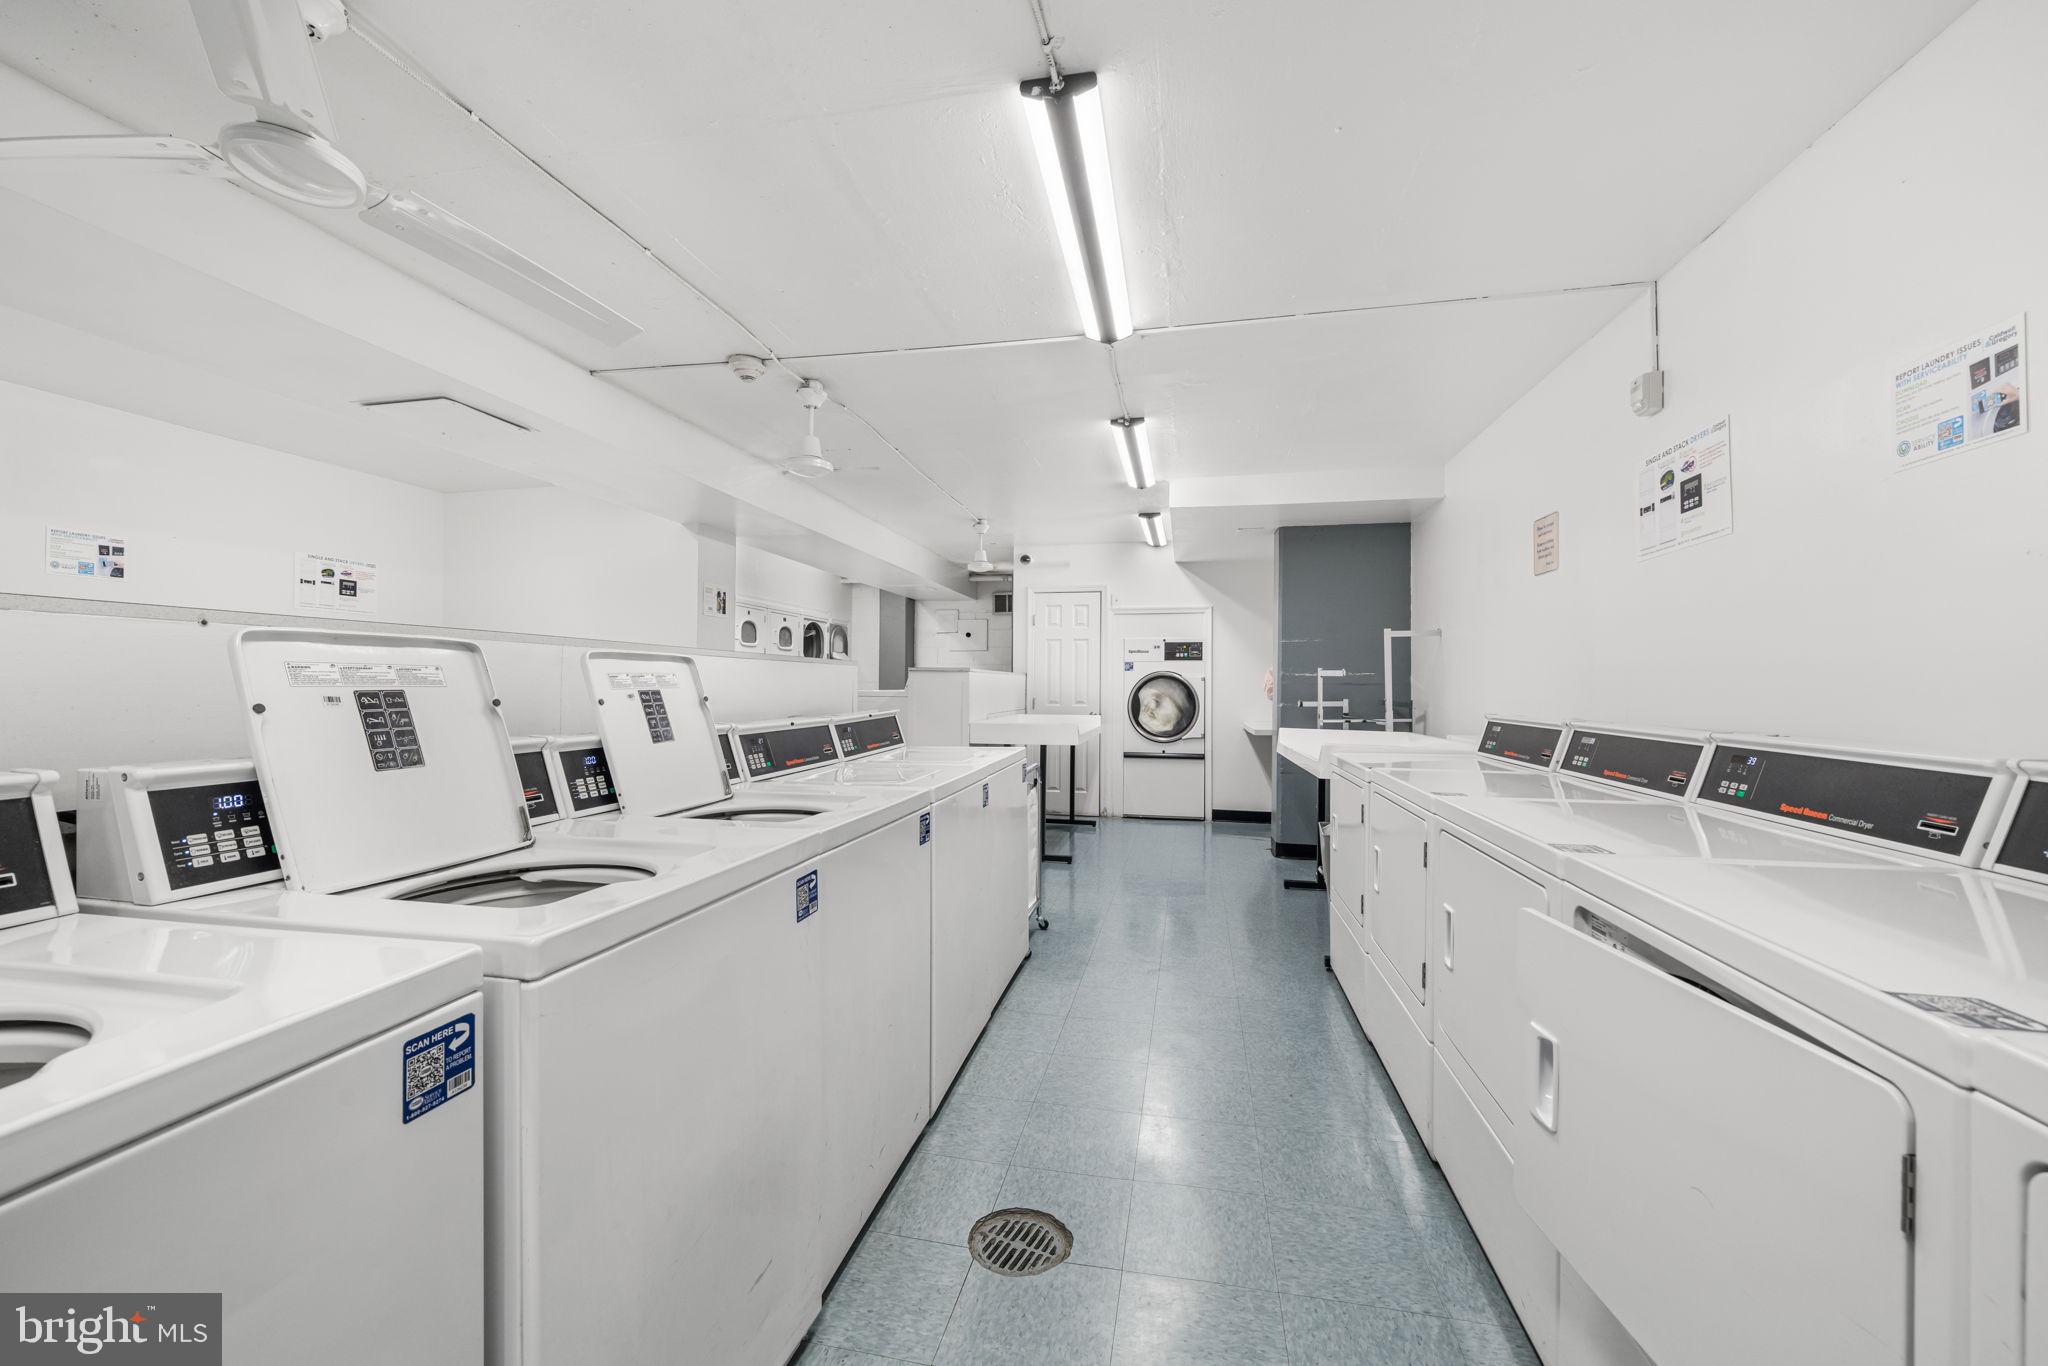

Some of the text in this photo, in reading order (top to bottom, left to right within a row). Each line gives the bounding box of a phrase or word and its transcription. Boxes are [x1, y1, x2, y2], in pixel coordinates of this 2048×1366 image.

[1895, 338, 1982, 381] REPORT LAUNDRY ISSUES
[1895, 353, 1968, 389] WITH SERVICEABILITY
[1645, 454, 1661, 467] SINGLE
[1661, 447, 1673, 459] AND
[1673, 439, 1689, 453] STACK
[1912, 439, 1935, 452] ABILITY
[217, 794, 244, 809] 1.00
[1780, 803, 1874, 830] Speed Queen Commercial Dryer
[405, 1026, 454, 1055] SCAN HERE
[446, 1046, 472, 1064] TO REPORT
